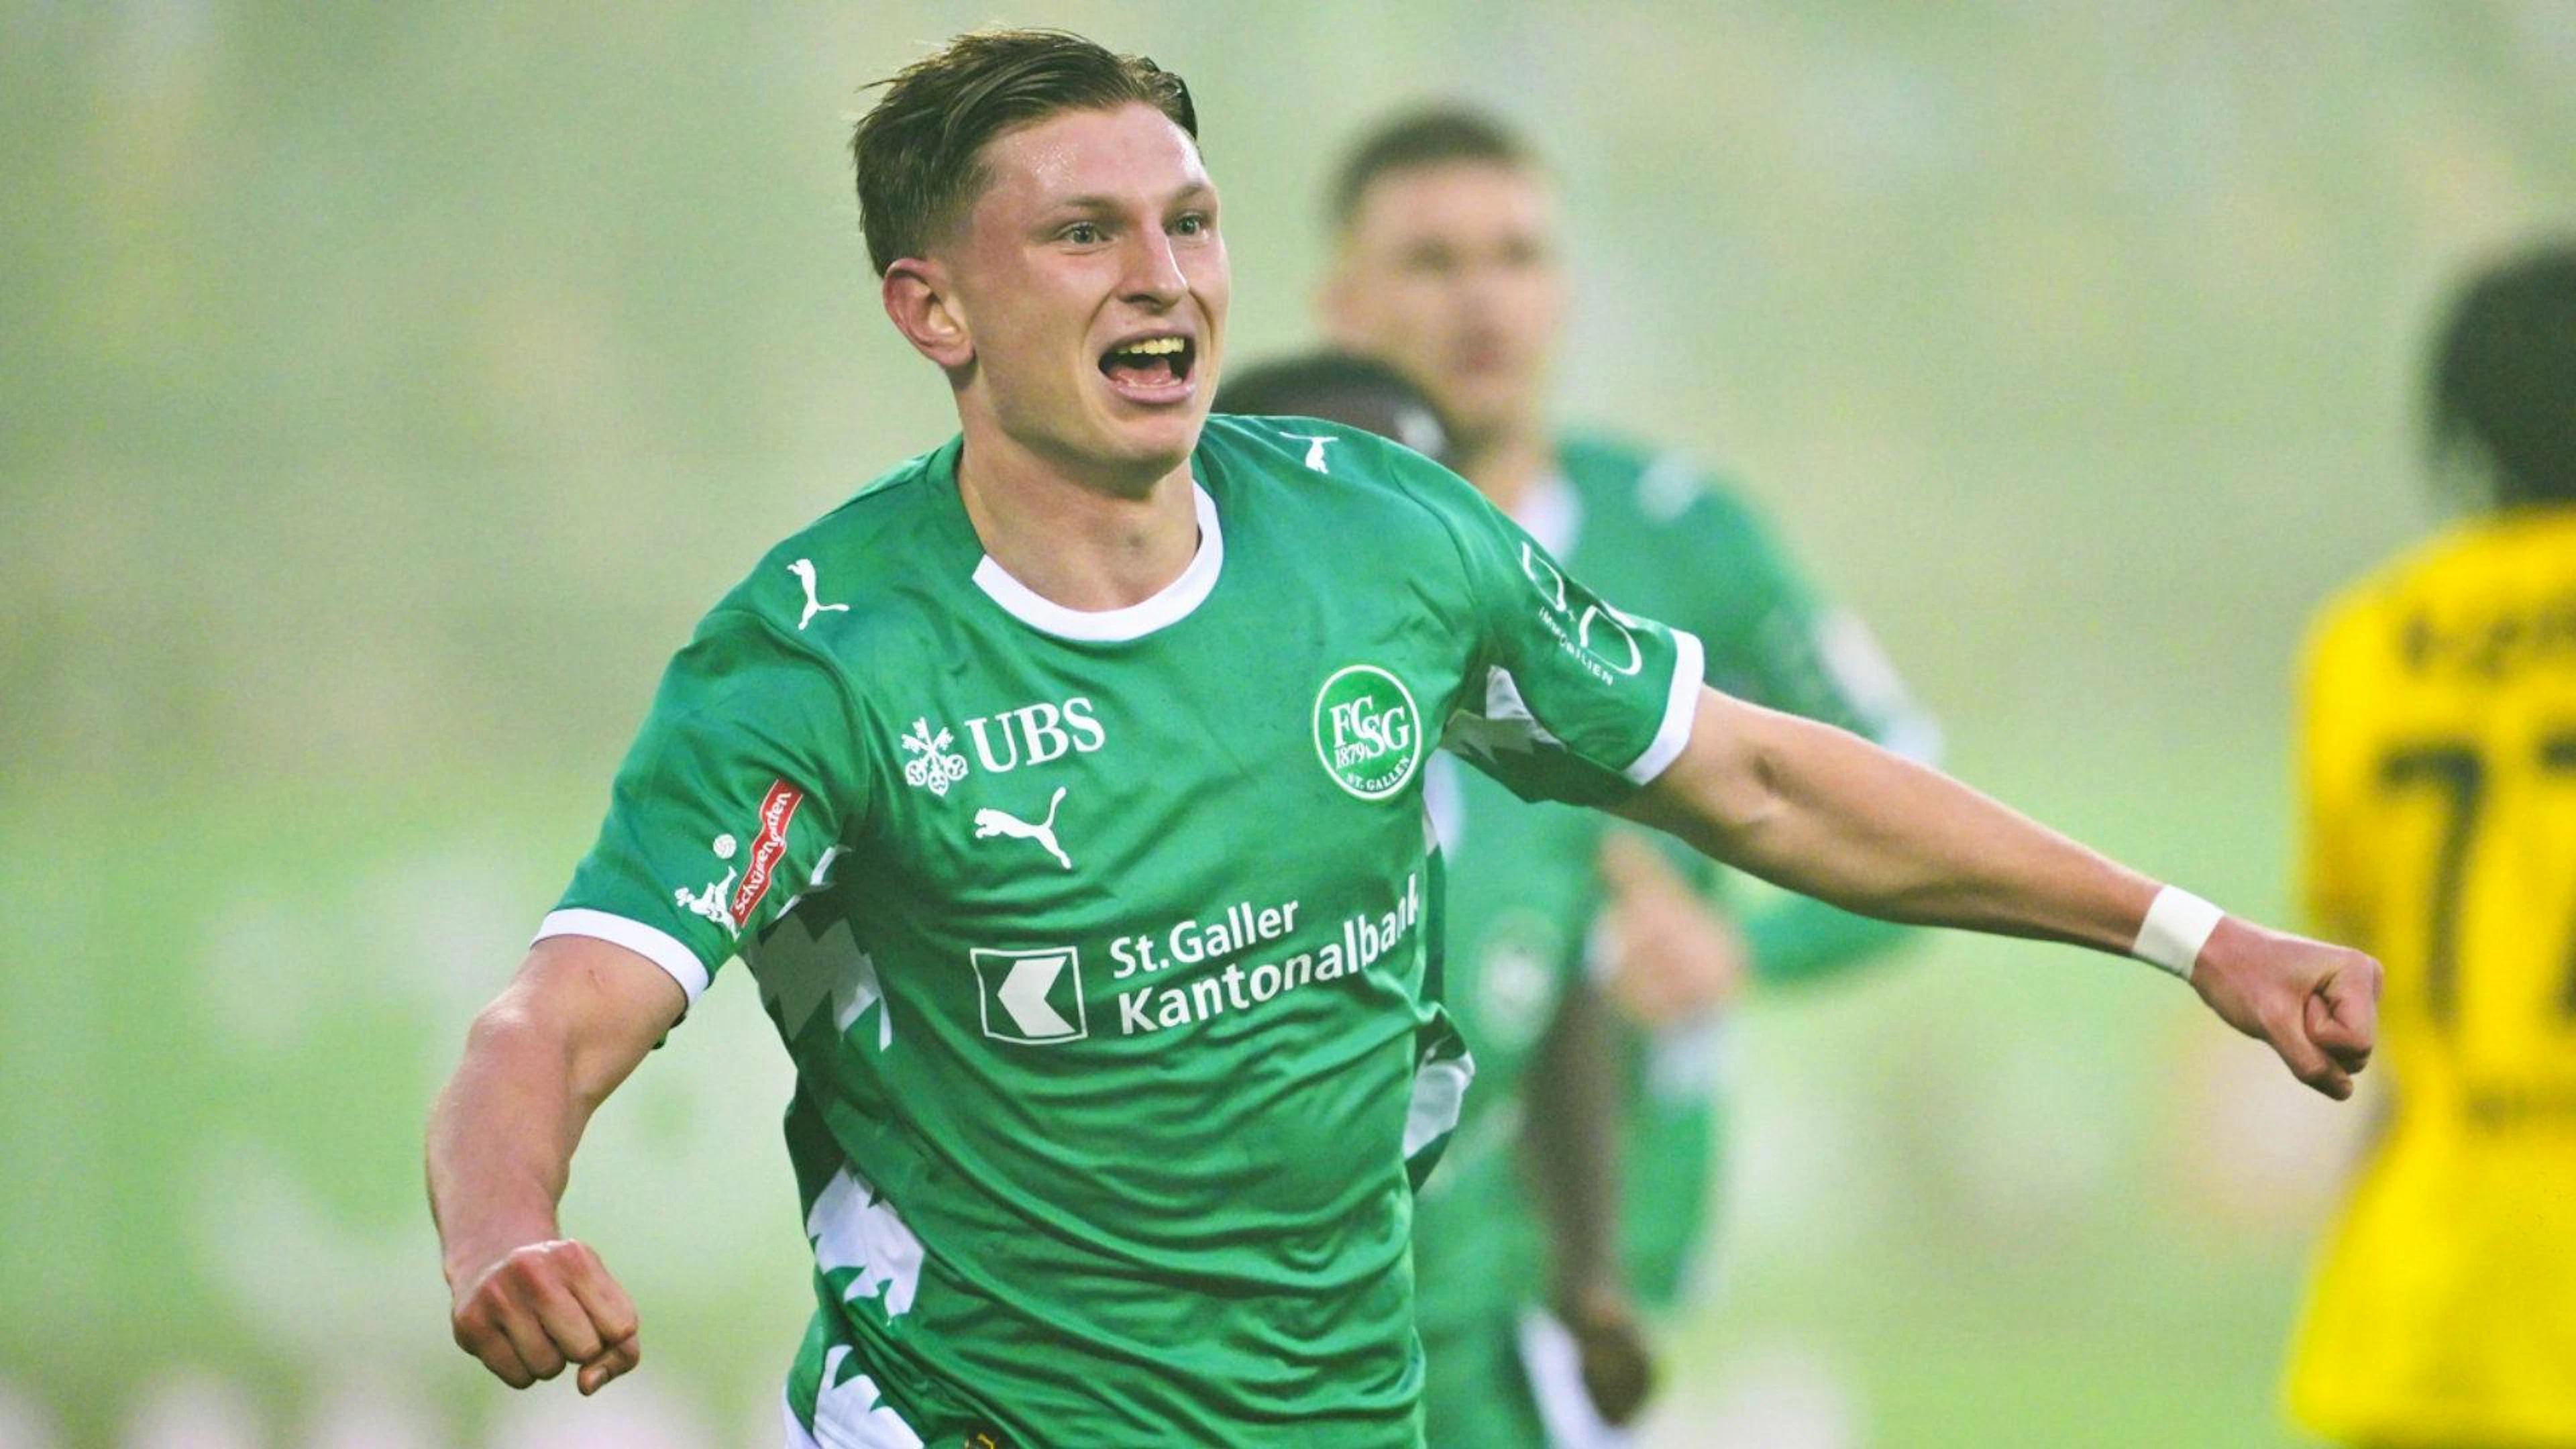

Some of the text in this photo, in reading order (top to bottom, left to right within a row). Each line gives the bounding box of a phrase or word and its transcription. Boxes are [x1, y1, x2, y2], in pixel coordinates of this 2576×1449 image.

[1538, 606, 1613, 686] IMMOBILIEN
[964, 697, 1106, 773] UBS
[1334, 741, 1366, 769] 1879
[1346, 757, 1411, 791] ST. GALLEN
[1118, 873, 1419, 1035] Kantonalbank
